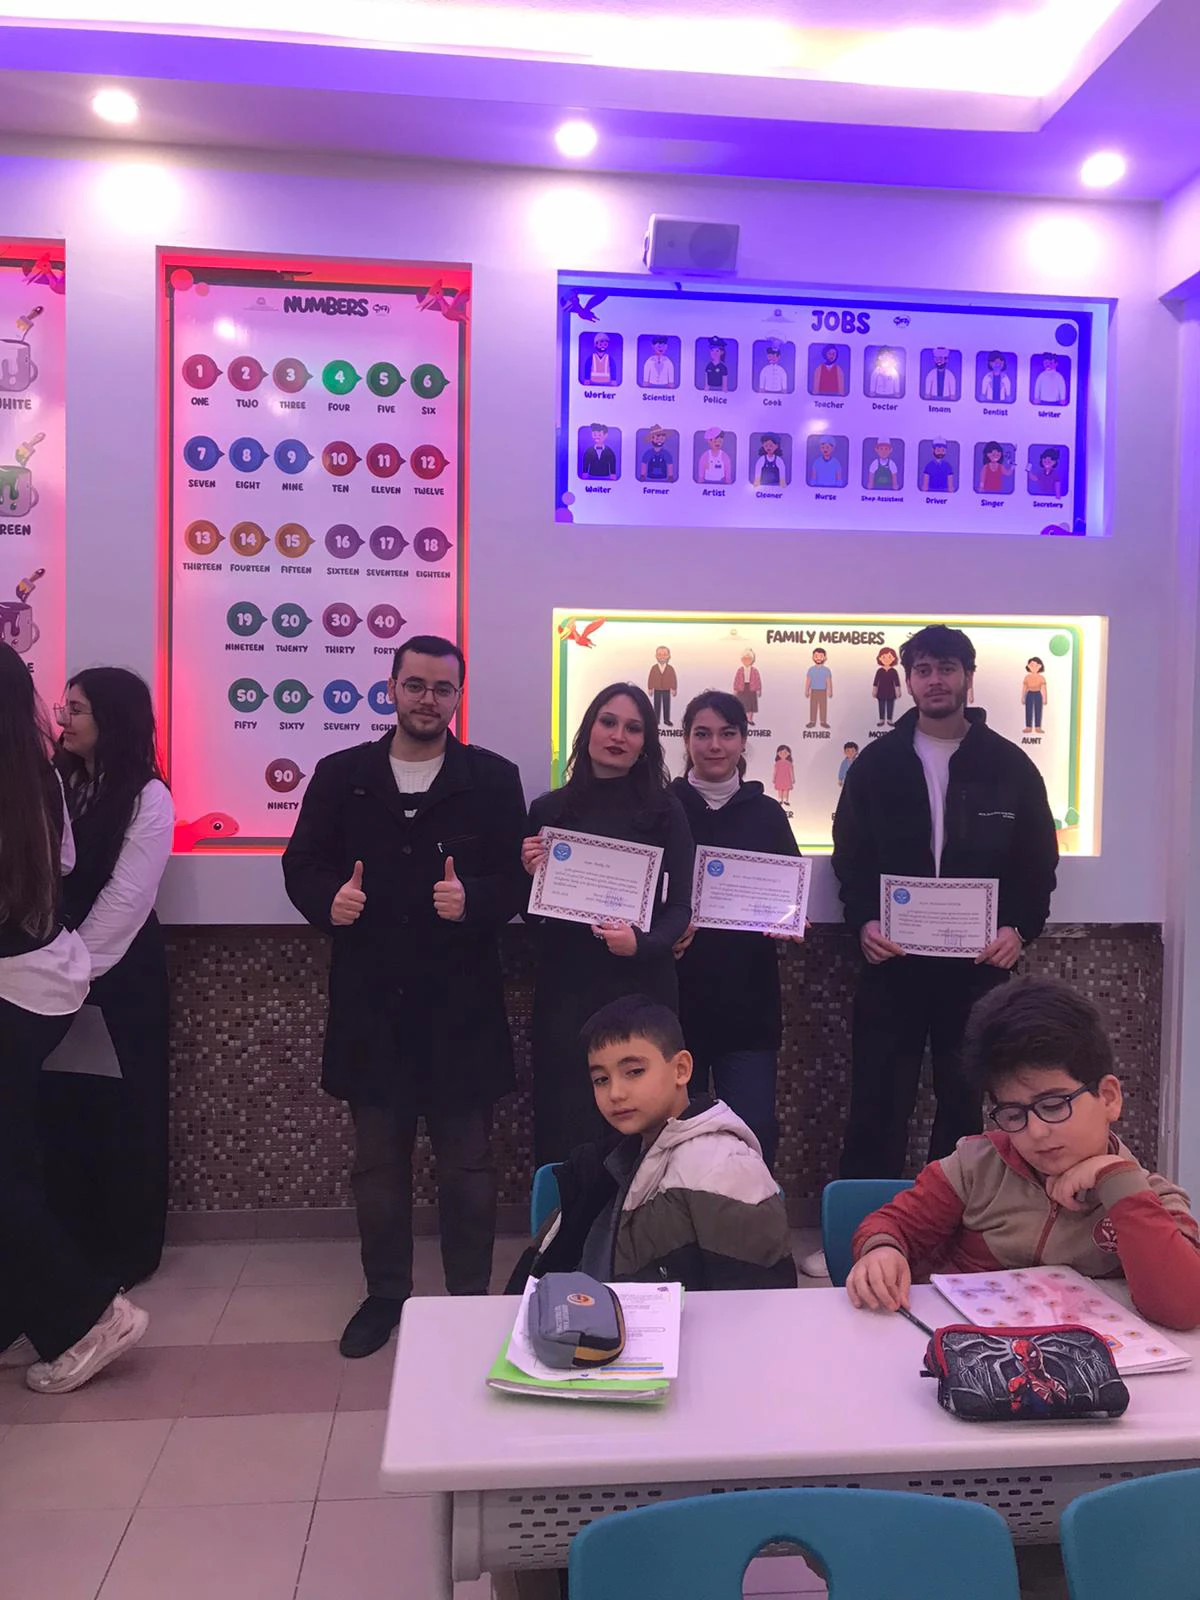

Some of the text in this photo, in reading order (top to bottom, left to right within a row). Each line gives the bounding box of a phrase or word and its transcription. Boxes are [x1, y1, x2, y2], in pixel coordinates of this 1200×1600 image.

[284, 295, 369, 317] NUMBERS
[811, 309, 871, 335] JOBS
[196, 366, 203, 377] 1
[242, 367, 250, 379] 2
[286, 369, 295, 381] 3
[335, 371, 345, 383] 4
[379, 372, 388, 384] 5
[423, 375, 432, 388] 6
[584, 391, 616, 400] Worker
[642, 393, 675, 402] Scientist
[703, 396, 727, 404] Police
[191, 397, 209, 407] ONE
[236, 399, 258, 408] TWO
[280, 401, 306, 409] THREE
[763, 398, 782, 407] Cook
[814, 401, 844, 409] Teacher
[328, 403, 350, 412] FOUR
[377, 404, 395, 413] FIVE
[422, 407, 436, 415] SIX
[872, 403, 898, 411] Doctor
[928, 405, 951, 413] Imam
[983, 408, 1008, 416] Dentist
[1038, 410, 1061, 418] Writer
[198, 448, 205, 460] 7
[243, 449, 251, 461] 8
[288, 451, 296, 463] 9
[331, 453, 347, 465] 10
[378, 454, 390, 467] 11
[421, 457, 435, 469] 12
[188, 479, 215, 489] SEVEN
[235, 481, 260, 490] EIGHT
[282, 483, 303, 491] NINE
[332, 484, 349, 493] TEN
[371, 486, 401, 495] ELEVEN
[414, 487, 444, 496] TWELVE
[585, 486, 611, 494] Waiter
[643, 487, 669, 495] Farmer
[702, 489, 725, 497] Artist
[756, 491, 783, 499] Cleaner
[815, 493, 837, 501] Nurse
[926, 497, 947, 505] Driver
[981, 499, 1004, 507] Singer
[1033, 501, 1063, 509] Secretary
[0, 524, 31, 536] REEN
[195, 532, 210, 544] 13
[240, 533, 256, 545] 14
[284, 534, 301, 547] 15
[336, 536, 351, 548] 16
[379, 537, 394, 550] 17
[424, 539, 438, 552] 18
[183, 563, 222, 571] THIRTEEN
[230, 564, 270, 573] FOURTEEN
[281, 566, 312, 574] FIFTEEN
[327, 568, 359, 576] SIXTEEN
[366, 569, 409, 577] SEVENTEEN
[416, 571, 450, 579] EIGHTEEN
[236, 613, 253, 626] 19
[281, 615, 300, 627] 20
[331, 614, 350, 627] 30
[374, 615, 395, 628] 40
[766, 629, 816, 644] FAMILY
[818, 631, 885, 645] MEMBERS
[225, 643, 264, 652] NINETEEN
[276, 644, 308, 653] TWENTY
[325, 646, 355, 654] THIRTY
[236, 690, 256, 703] 50
[282, 691, 301, 704] 60
[332, 690, 352, 703] 70
[234, 721, 257, 730] FIFTY
[280, 722, 304, 731] SIXTY
[324, 723, 360, 731] SEVENTY
[747, 729, 772, 737] OTHER
[802, 730, 831, 739] FATHER
[1021, 737, 1042, 745] AUNT
[274, 770, 293, 782] 90
[267, 801, 299, 810] NINETY
